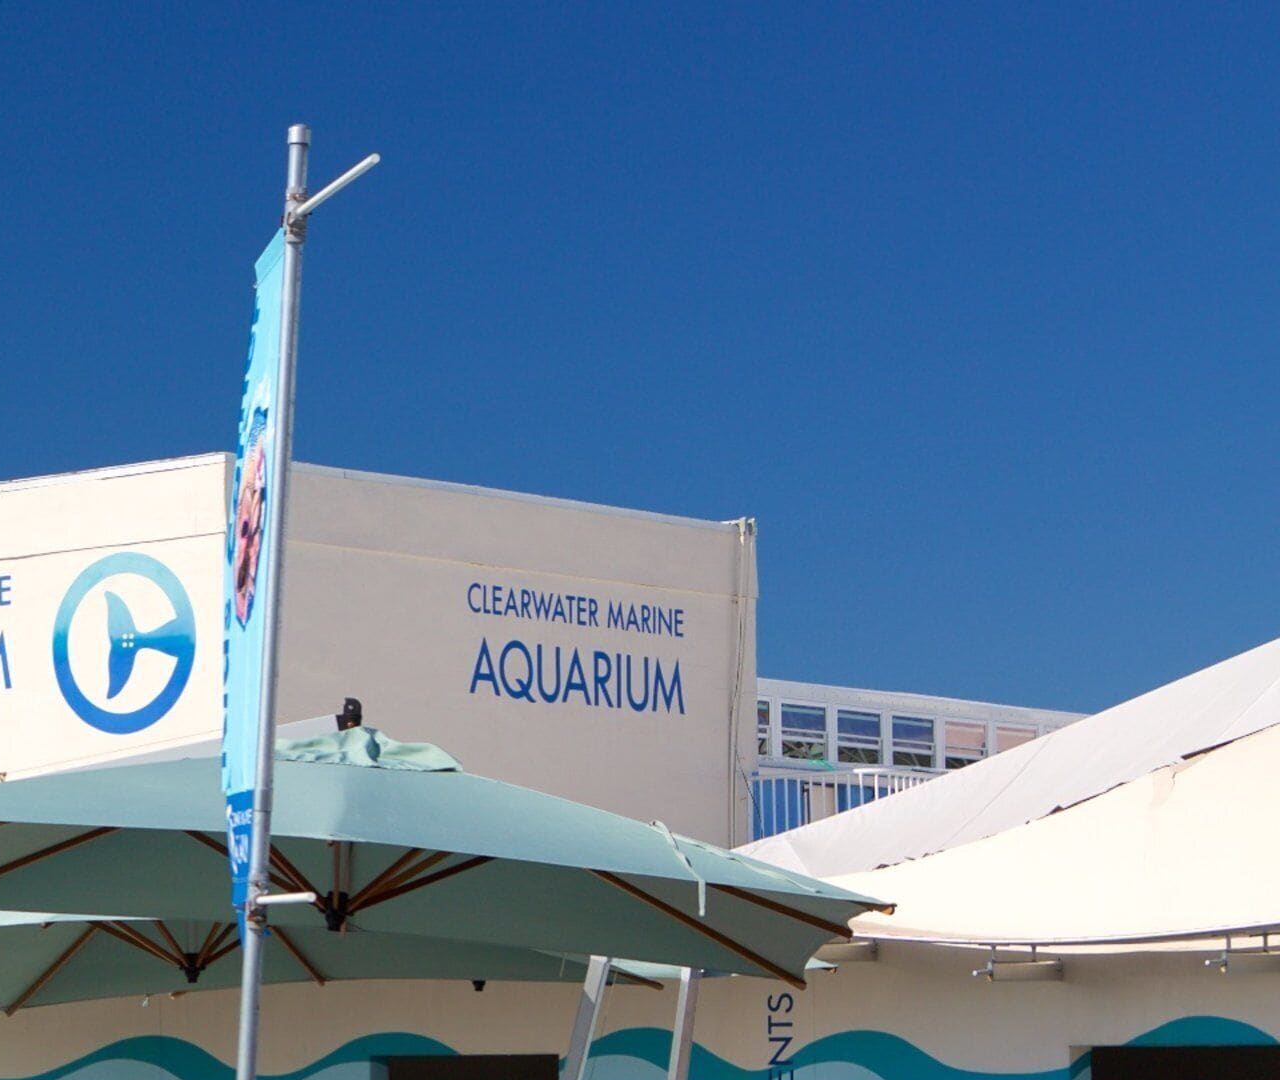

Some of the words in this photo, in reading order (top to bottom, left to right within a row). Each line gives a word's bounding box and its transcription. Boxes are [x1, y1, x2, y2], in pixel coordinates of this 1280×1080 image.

[467, 582, 600, 627] CLEARWATER
[607, 600, 684, 637] MARINE
[469, 636, 686, 714] AQUARIUM
